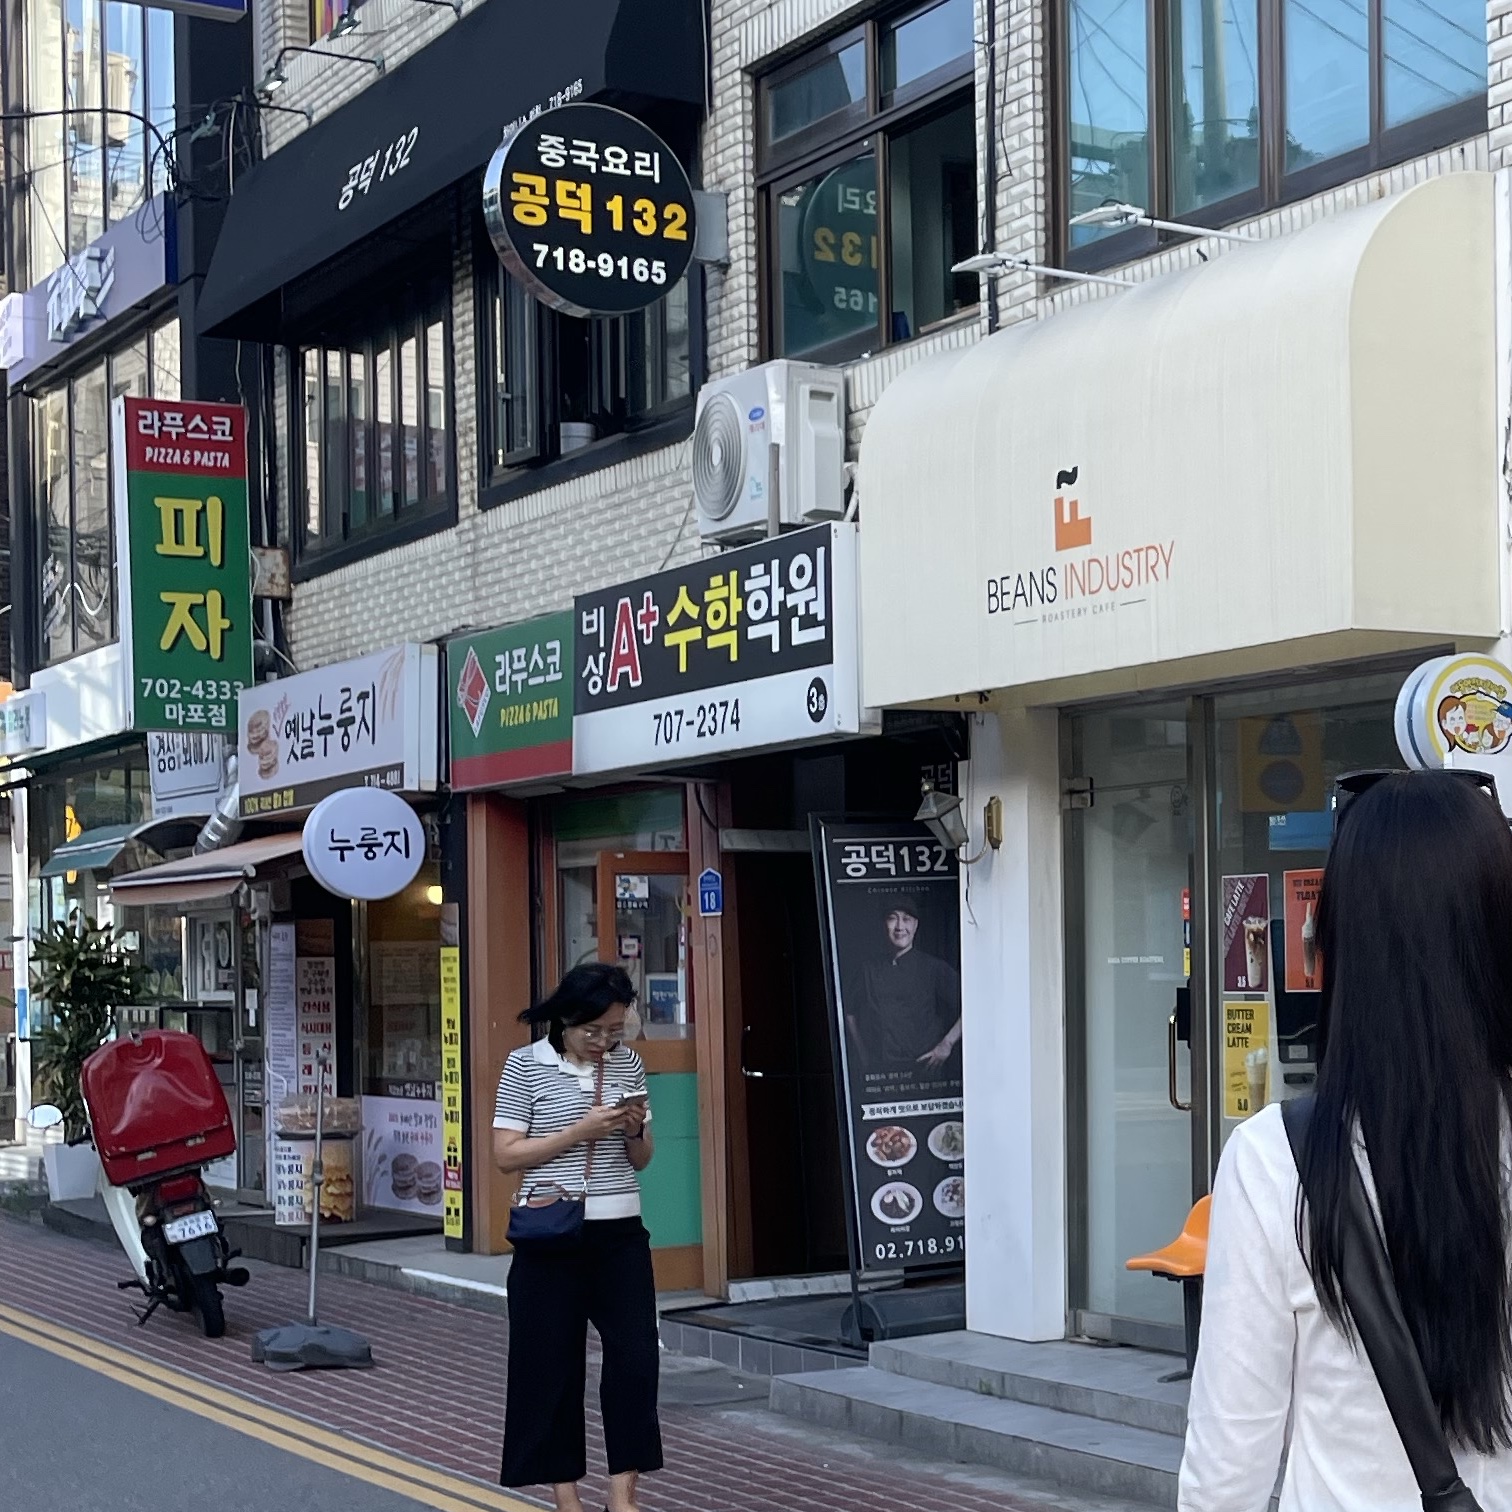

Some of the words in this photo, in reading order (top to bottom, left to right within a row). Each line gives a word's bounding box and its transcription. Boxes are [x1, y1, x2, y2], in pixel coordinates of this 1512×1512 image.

[338, 149, 381, 211] 공덕
[380, 126, 419, 182] 132
[537, 133, 660, 184] 중국요리
[510, 171, 593, 235] 공덕
[606, 194, 688, 241] 132
[532, 243, 667, 285] 718-9165
[137, 409, 234, 441] 라푸스코
[145, 446, 181, 465] PIZZA
[193, 450, 230, 468] PASTA
[153, 496, 231, 661] 피자
[987, 566, 1058, 614] BEANS
[1063, 540, 1175, 600] INDUSTRY
[664, 546, 826, 674] 수학학원
[1042, 607, 1088, 623] ROASTERY
[1092, 601, 1116, 615] CAFE
[495, 639, 563, 696] 라푸스코
[141, 678, 245, 700] 702-4333
[164, 703, 227, 727] 마포점
[284, 682, 377, 765] 옛날누룽지
[500, 703, 524, 729] PIZZA
[532, 697, 559, 722] PASTA
[653, 698, 741, 746] 707-2374
[328, 827, 411, 863] 누룽지
[704, 891, 716, 910] 18
[1230, 880, 1245, 907] LATTE
[1226, 1008, 1255, 1020] BUTTER
[1226, 1022, 1252, 1034] CREAM
[1226, 1036, 1250, 1048] LATTE
